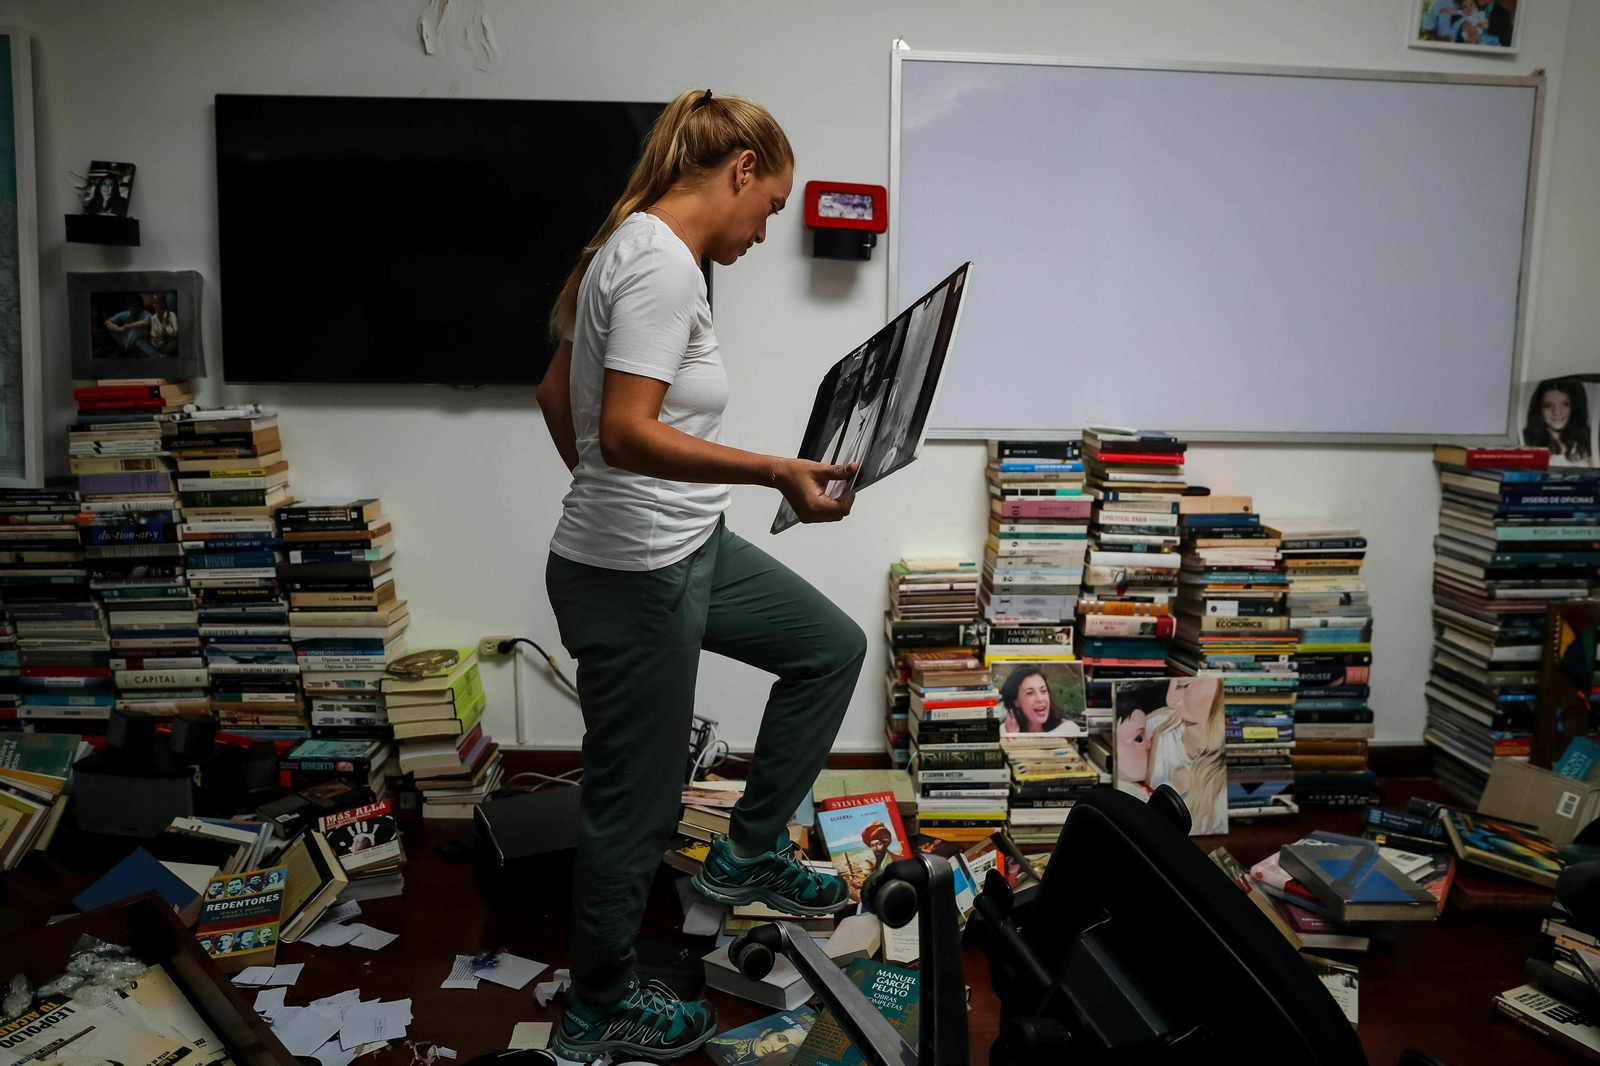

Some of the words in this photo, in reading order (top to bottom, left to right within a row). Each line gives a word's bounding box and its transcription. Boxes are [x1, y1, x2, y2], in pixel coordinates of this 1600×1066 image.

[1549, 496, 1560, 504] DE
[1215, 621, 1263, 629] ECONOMICS
[134, 676, 177, 685] CAPITAL
[301, 761, 335, 770] BENEDETTI
[831, 799, 863, 809] SYLVIA
[863, 795, 892, 805] NASAR
[326, 811, 351, 824] Más
[205, 893, 280, 913] REDENTORES
[249, 908, 271, 916] LATINA
[876, 968, 918, 986] MANUEL
[871, 982, 909, 998] PELAYO
[876, 977, 911, 992] GARCÍA
[873, 992, 899, 1005] OBRAS
[0, 1005, 77, 1050] LEOPOLDO
